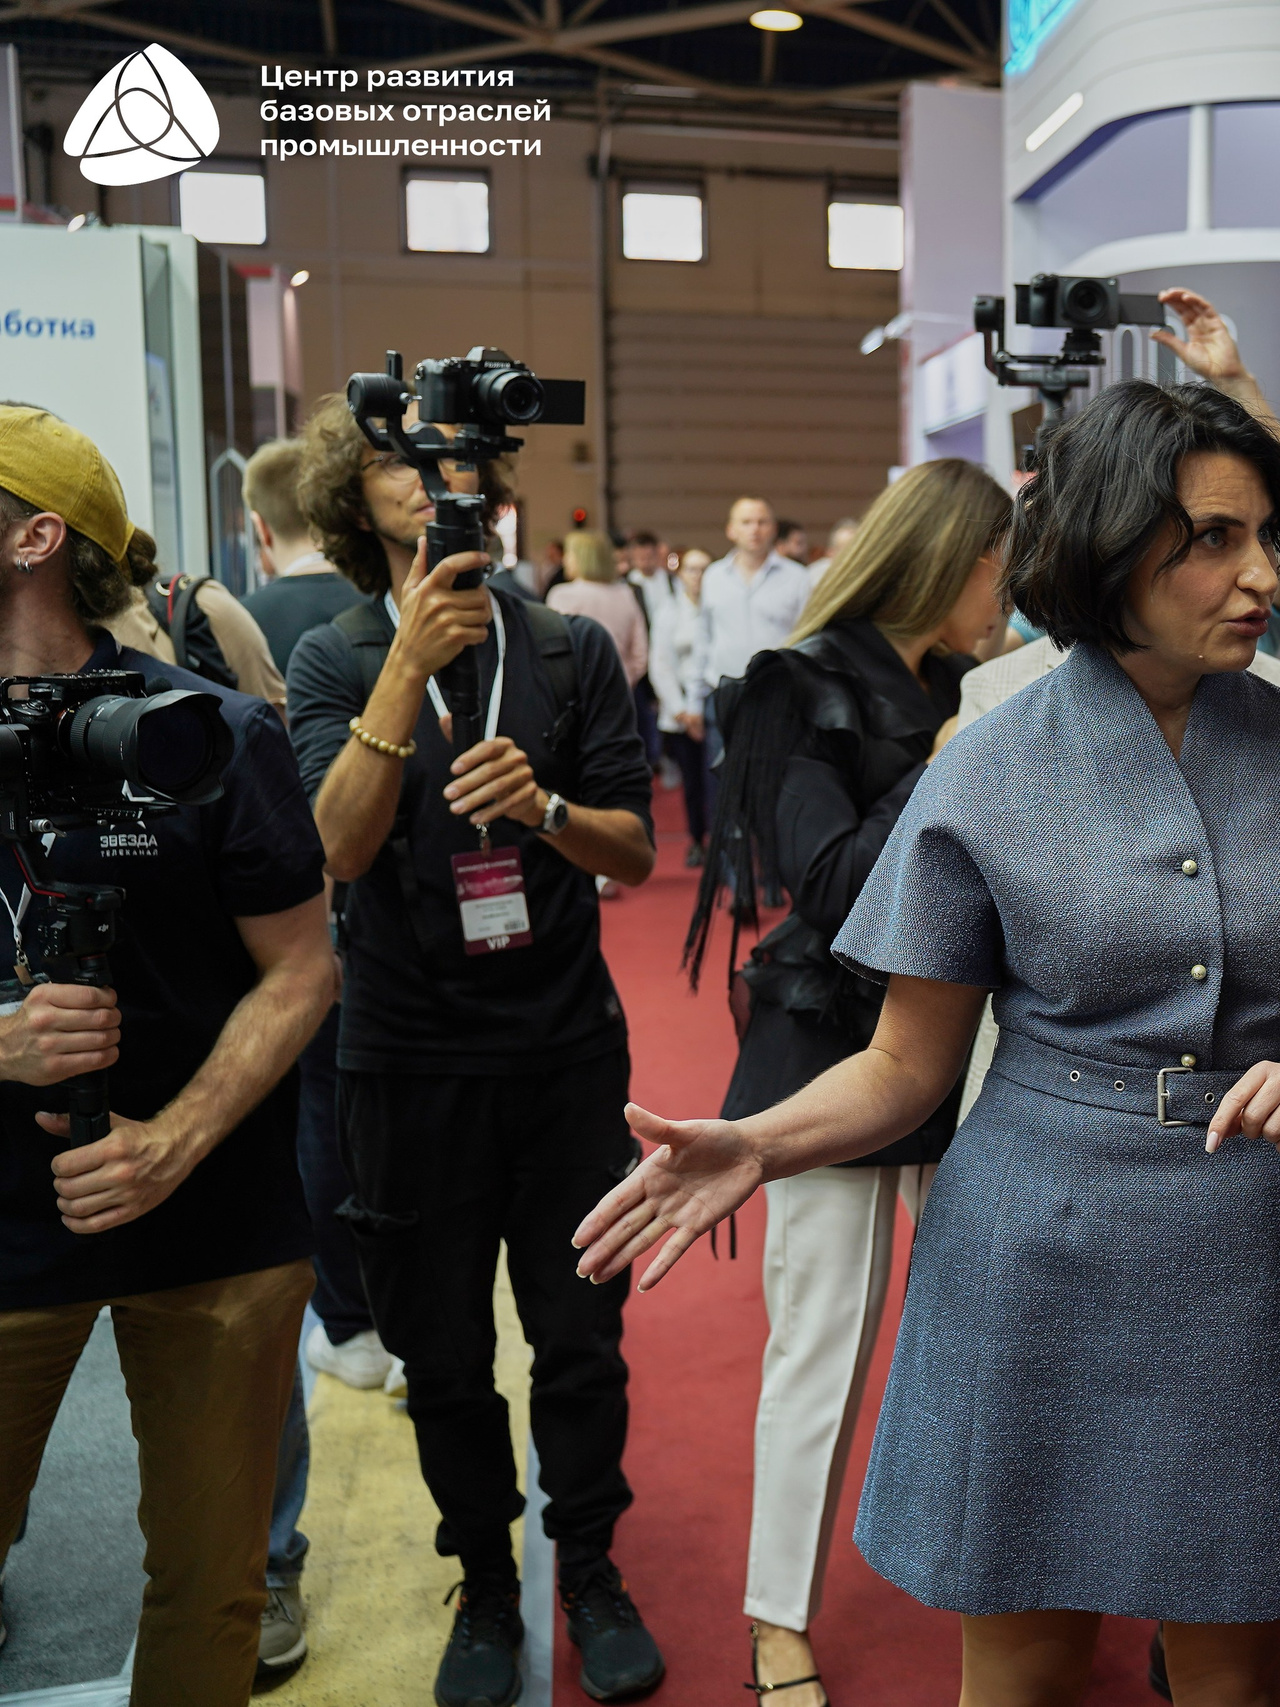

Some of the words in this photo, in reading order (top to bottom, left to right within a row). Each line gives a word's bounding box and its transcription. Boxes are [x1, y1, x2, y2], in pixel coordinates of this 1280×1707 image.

[0, 309, 95, 339] ботка
[100, 834, 158, 848] ЗВЕЗДА
[101, 849, 158, 857] ТЕЛЕКАНАЛ
[486, 935, 511, 951] VIP
